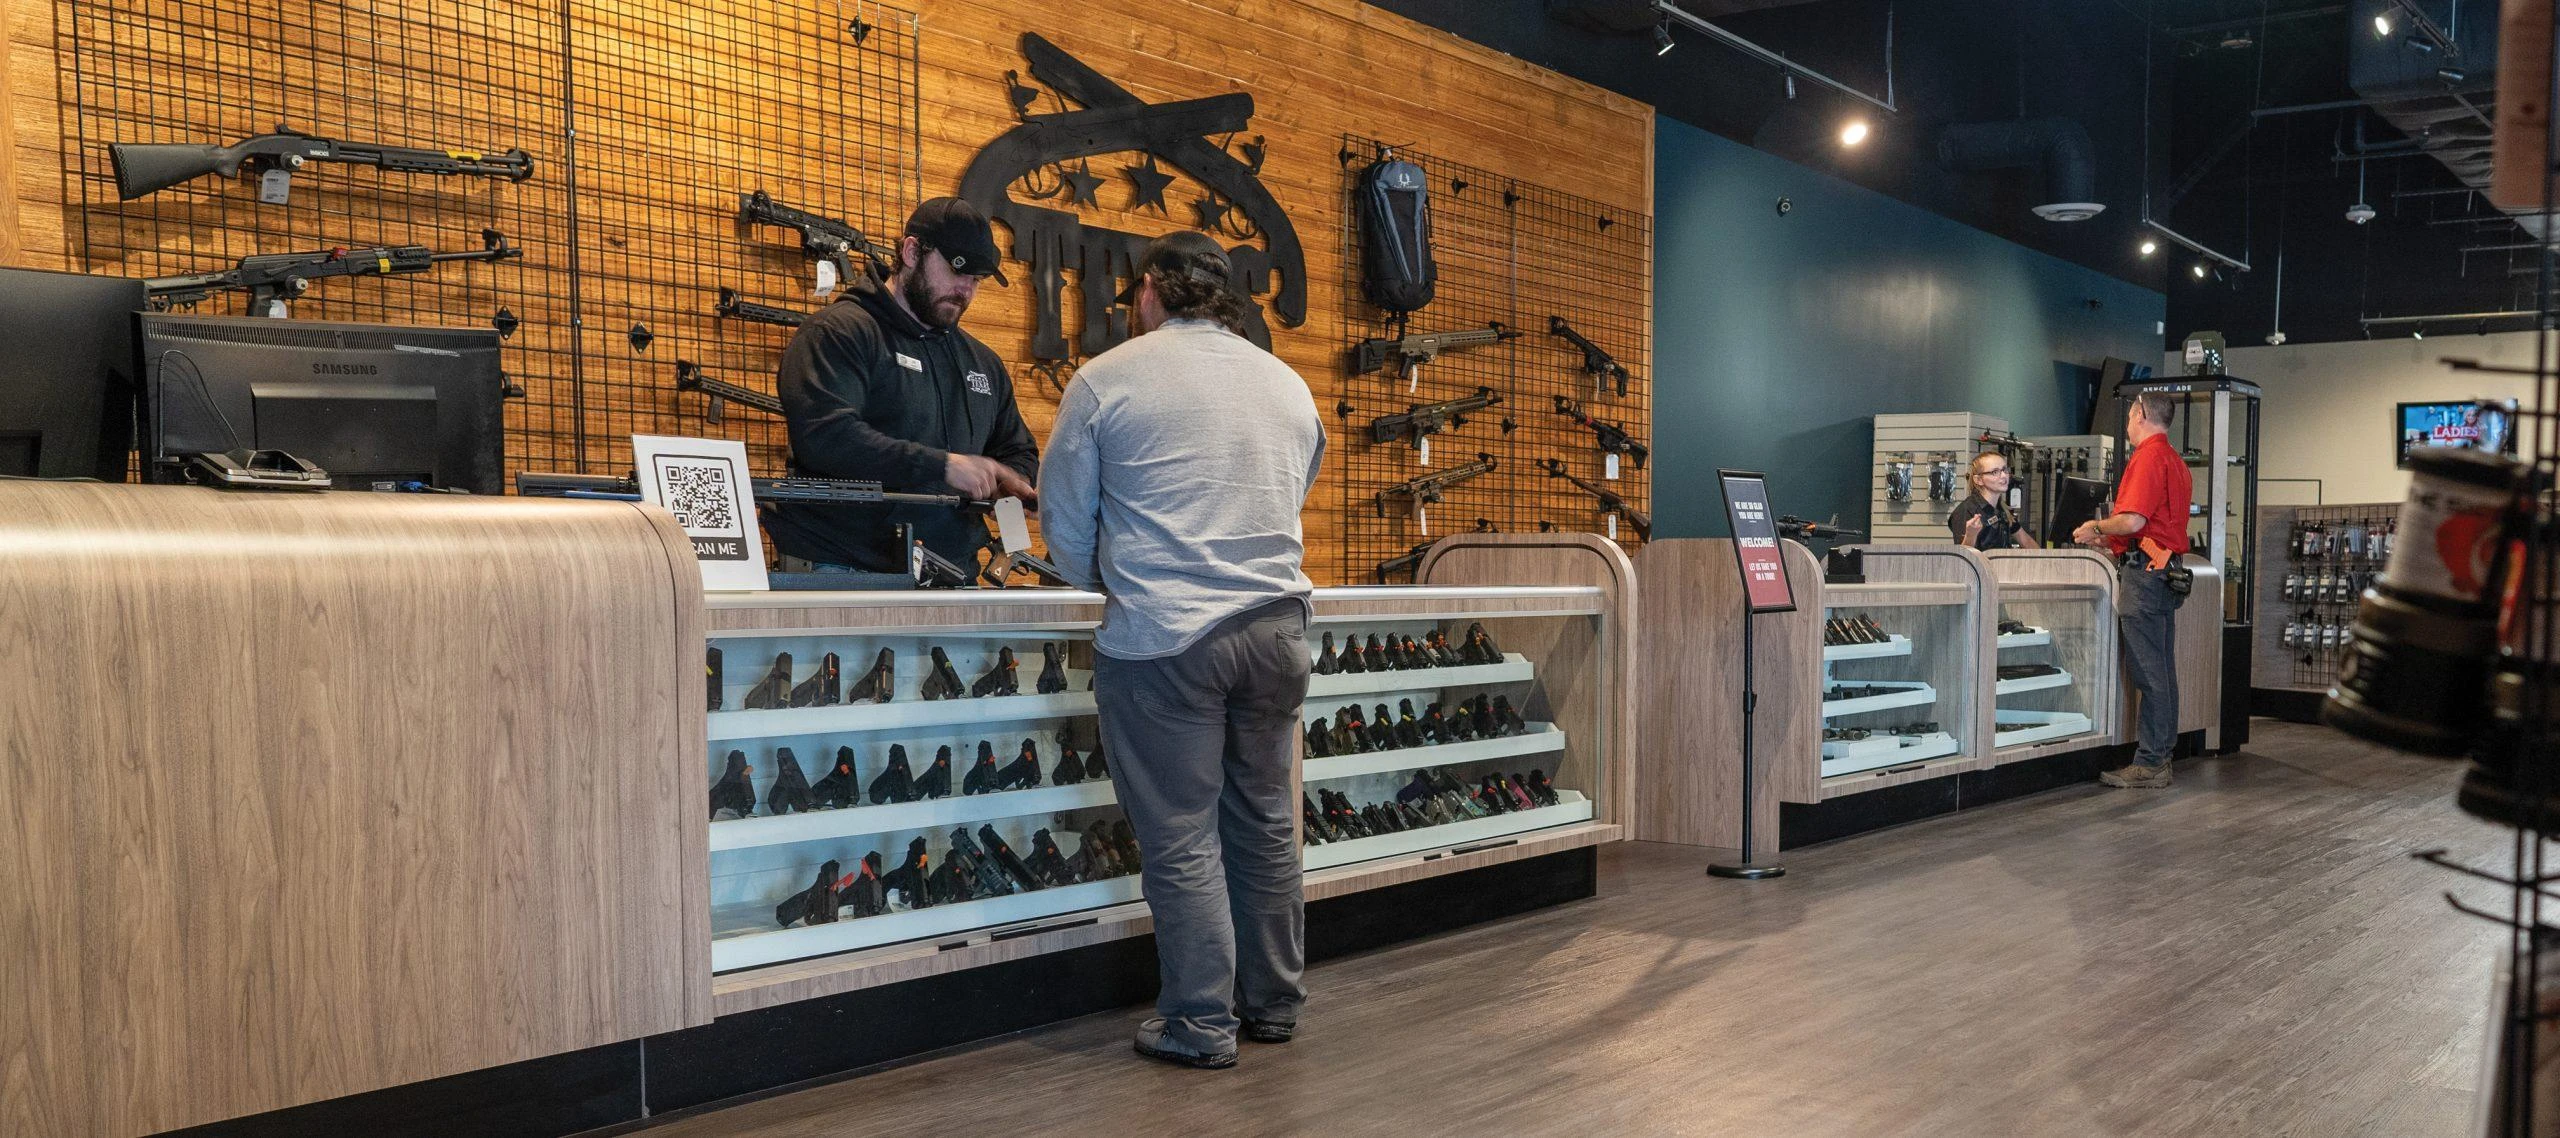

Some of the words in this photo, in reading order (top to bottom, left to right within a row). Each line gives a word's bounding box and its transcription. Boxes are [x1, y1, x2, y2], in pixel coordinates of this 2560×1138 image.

[313, 363, 378, 375] SAMSUNG
[2433, 424, 2479, 438] LADIES
[692, 542, 716, 554] CAN
[718, 542, 738, 555] ME
[1740, 537, 1775, 548] WELCOME!
